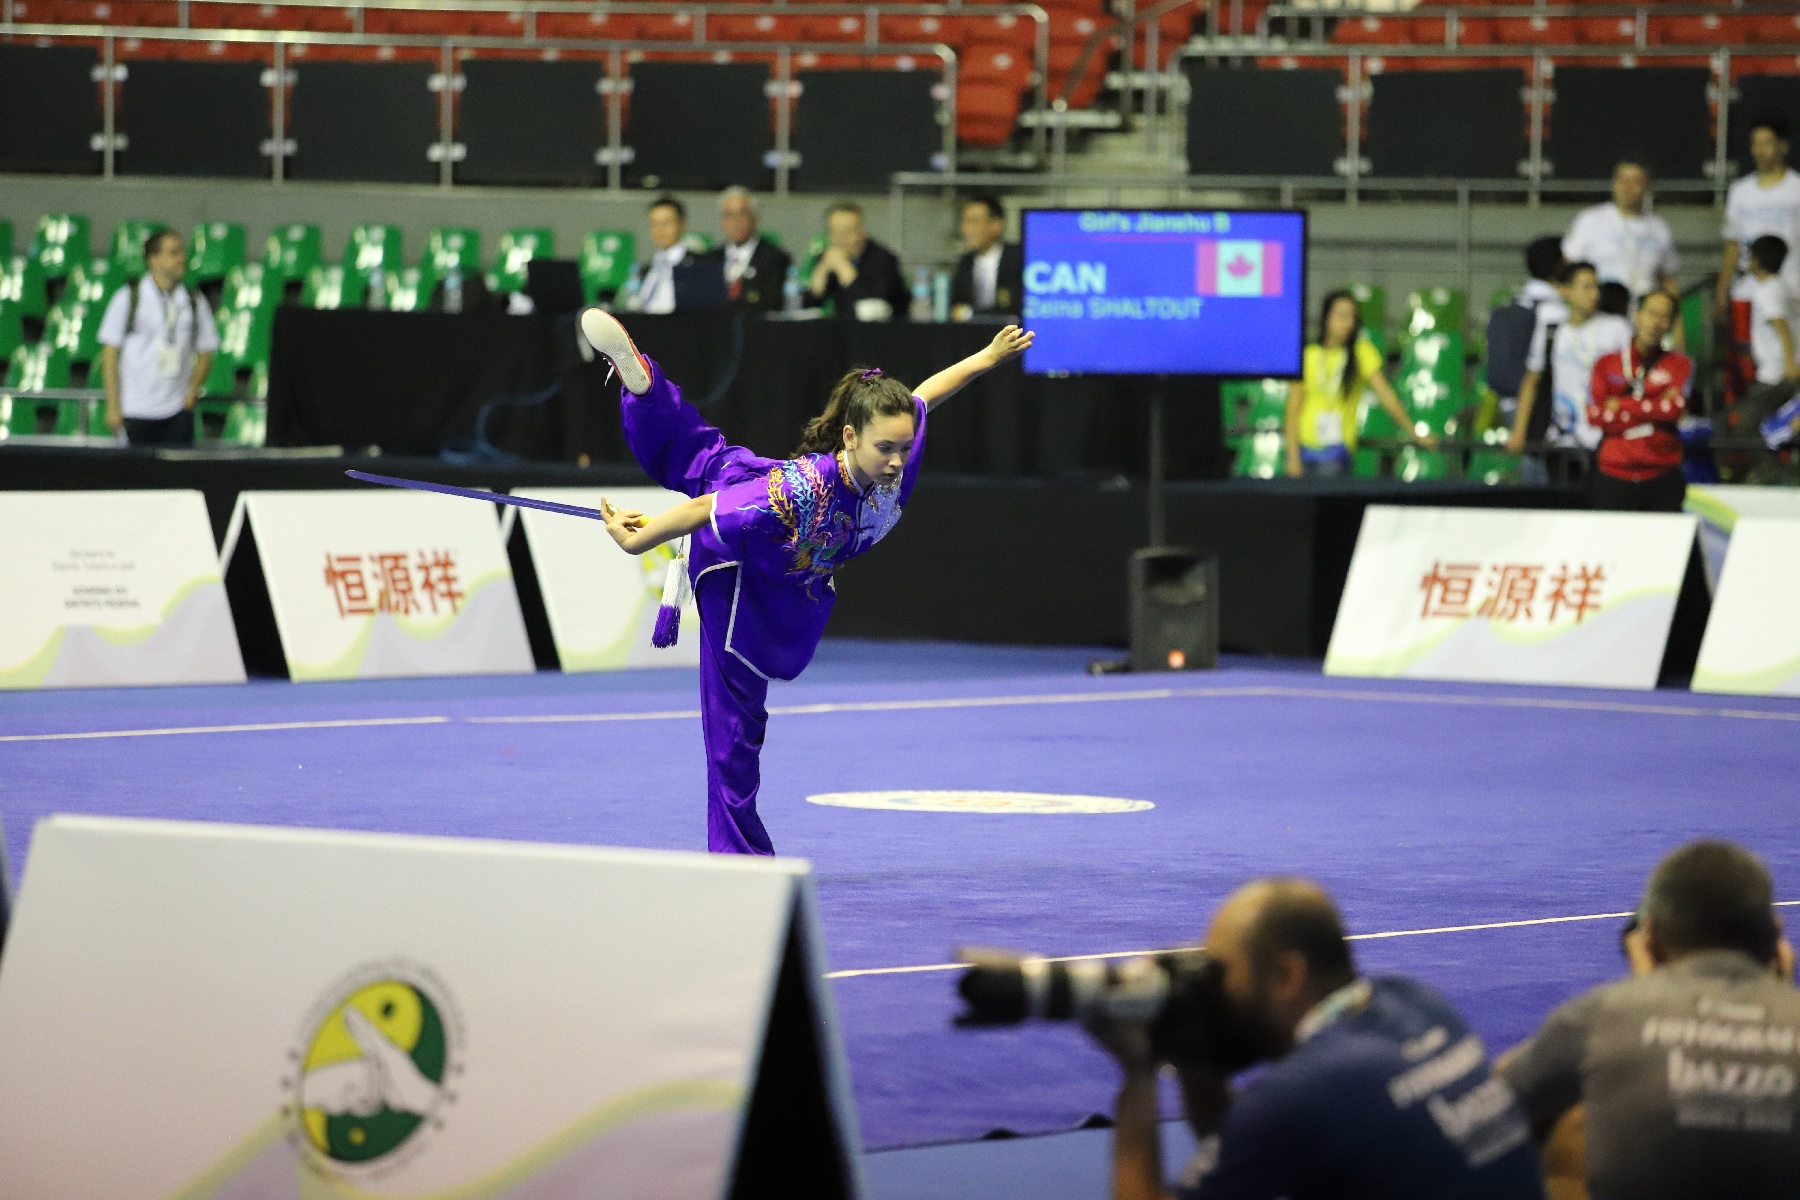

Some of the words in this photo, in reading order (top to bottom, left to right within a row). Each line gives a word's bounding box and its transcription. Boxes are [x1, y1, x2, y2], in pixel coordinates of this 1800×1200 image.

[1023, 261, 1107, 294] CAN
[1087, 296, 1203, 320] SHALTOUT
[323, 548, 465, 619] 恒源祥
[1418, 560, 1607, 624] 恒源祥
